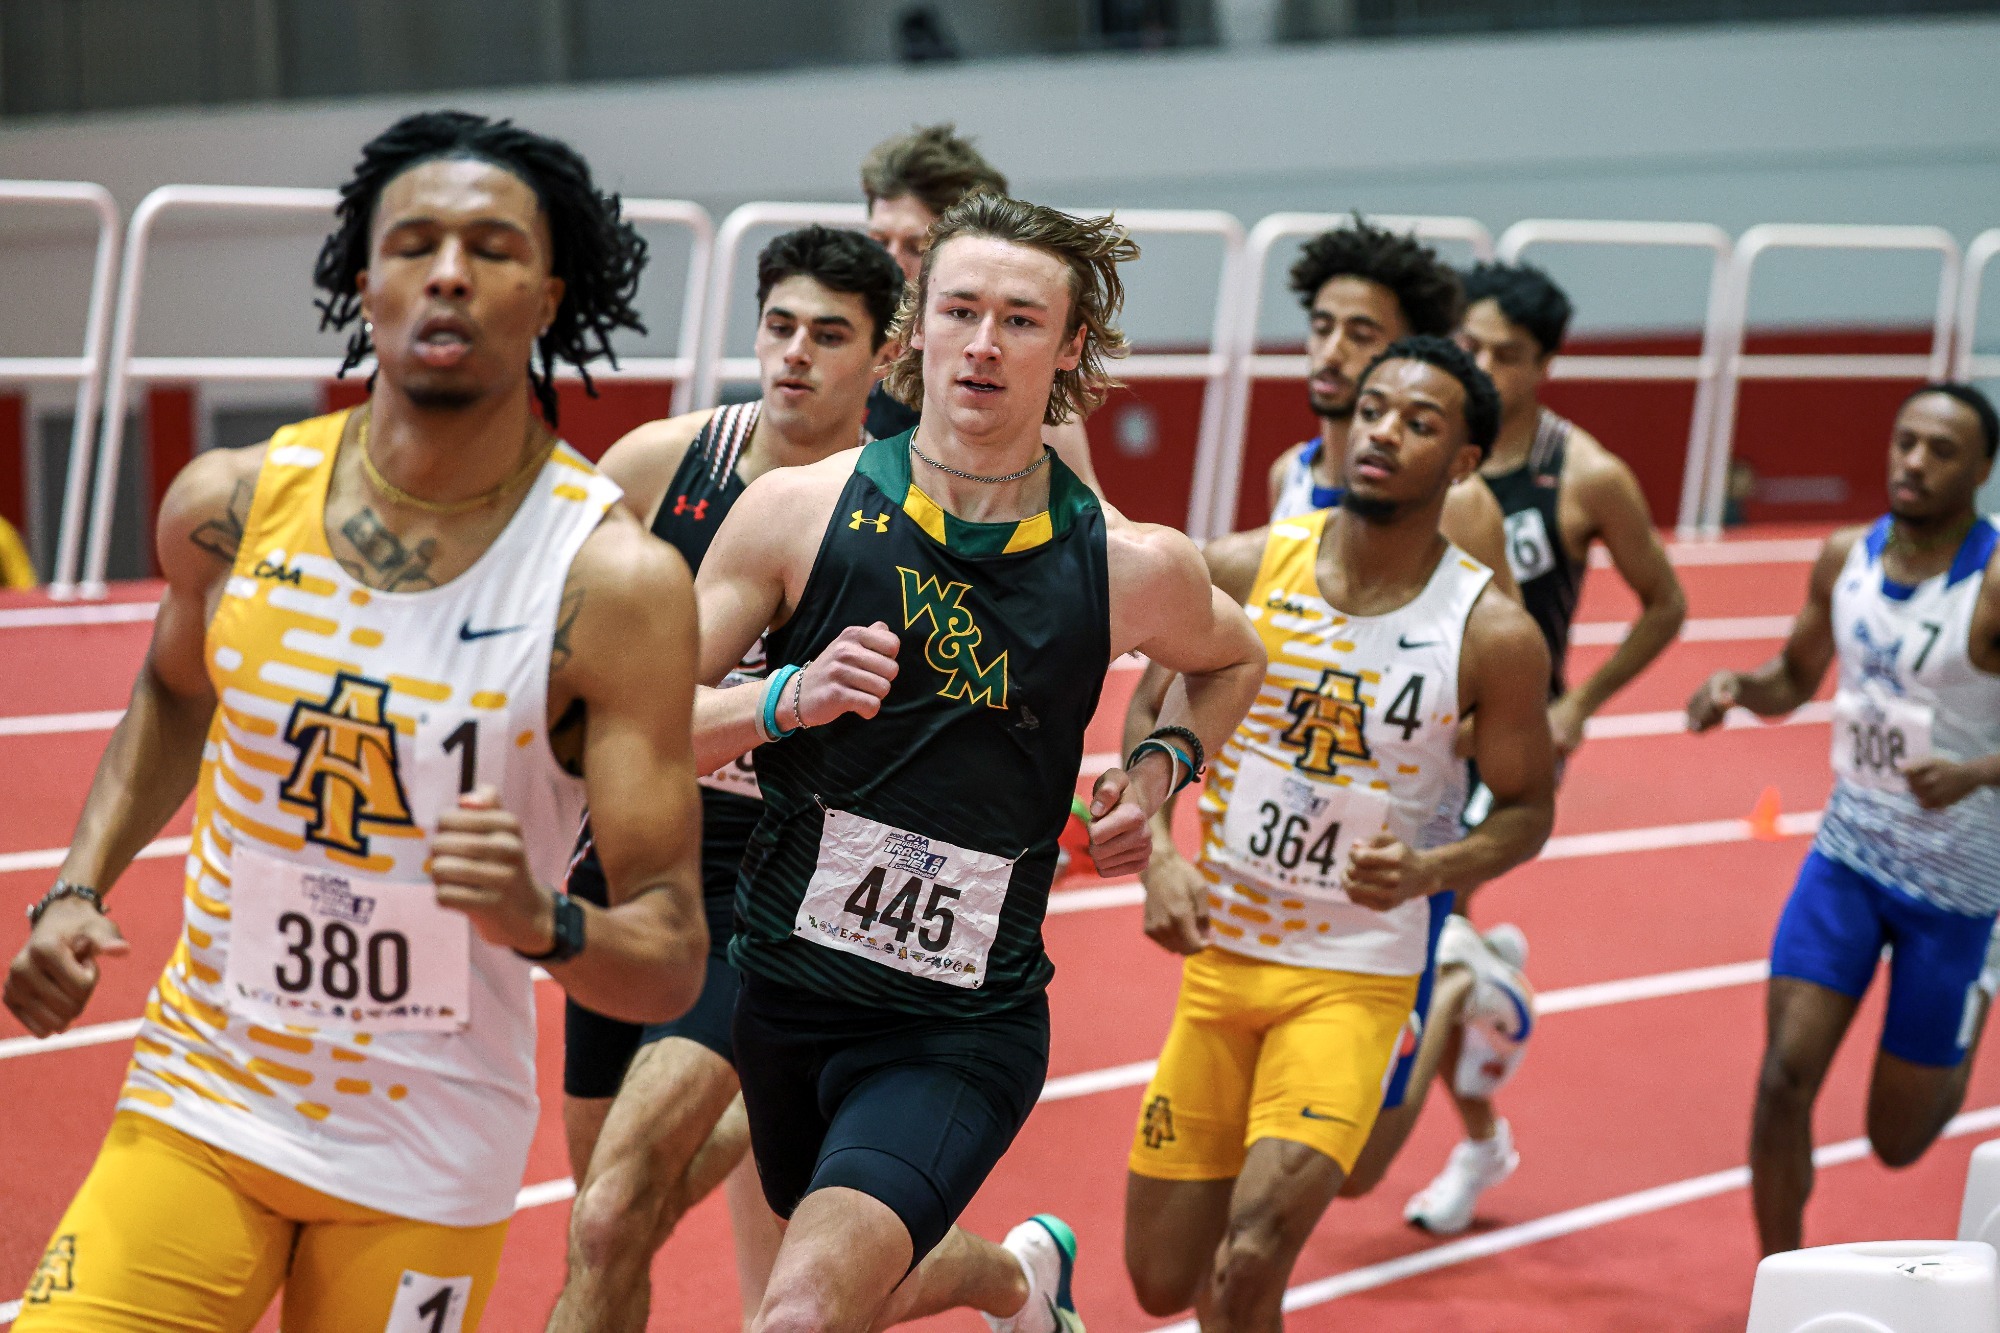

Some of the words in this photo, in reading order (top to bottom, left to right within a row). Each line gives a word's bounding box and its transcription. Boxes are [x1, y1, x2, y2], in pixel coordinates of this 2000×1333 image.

[1514, 516, 1540, 570] 6
[254, 560, 302, 585] CAA
[1912, 622, 1942, 673] 7
[1384, 674, 1427, 741] 4
[442, 719, 478, 794] 1
[884, 837, 930, 863] TRACK
[888, 853, 940, 875] FIELD
[904, 833, 929, 849] CAA
[1250, 800, 1341, 876] 364
[843, 866, 961, 953] 445
[275, 911, 409, 1004] 380
[417, 1285, 453, 1333] 1
